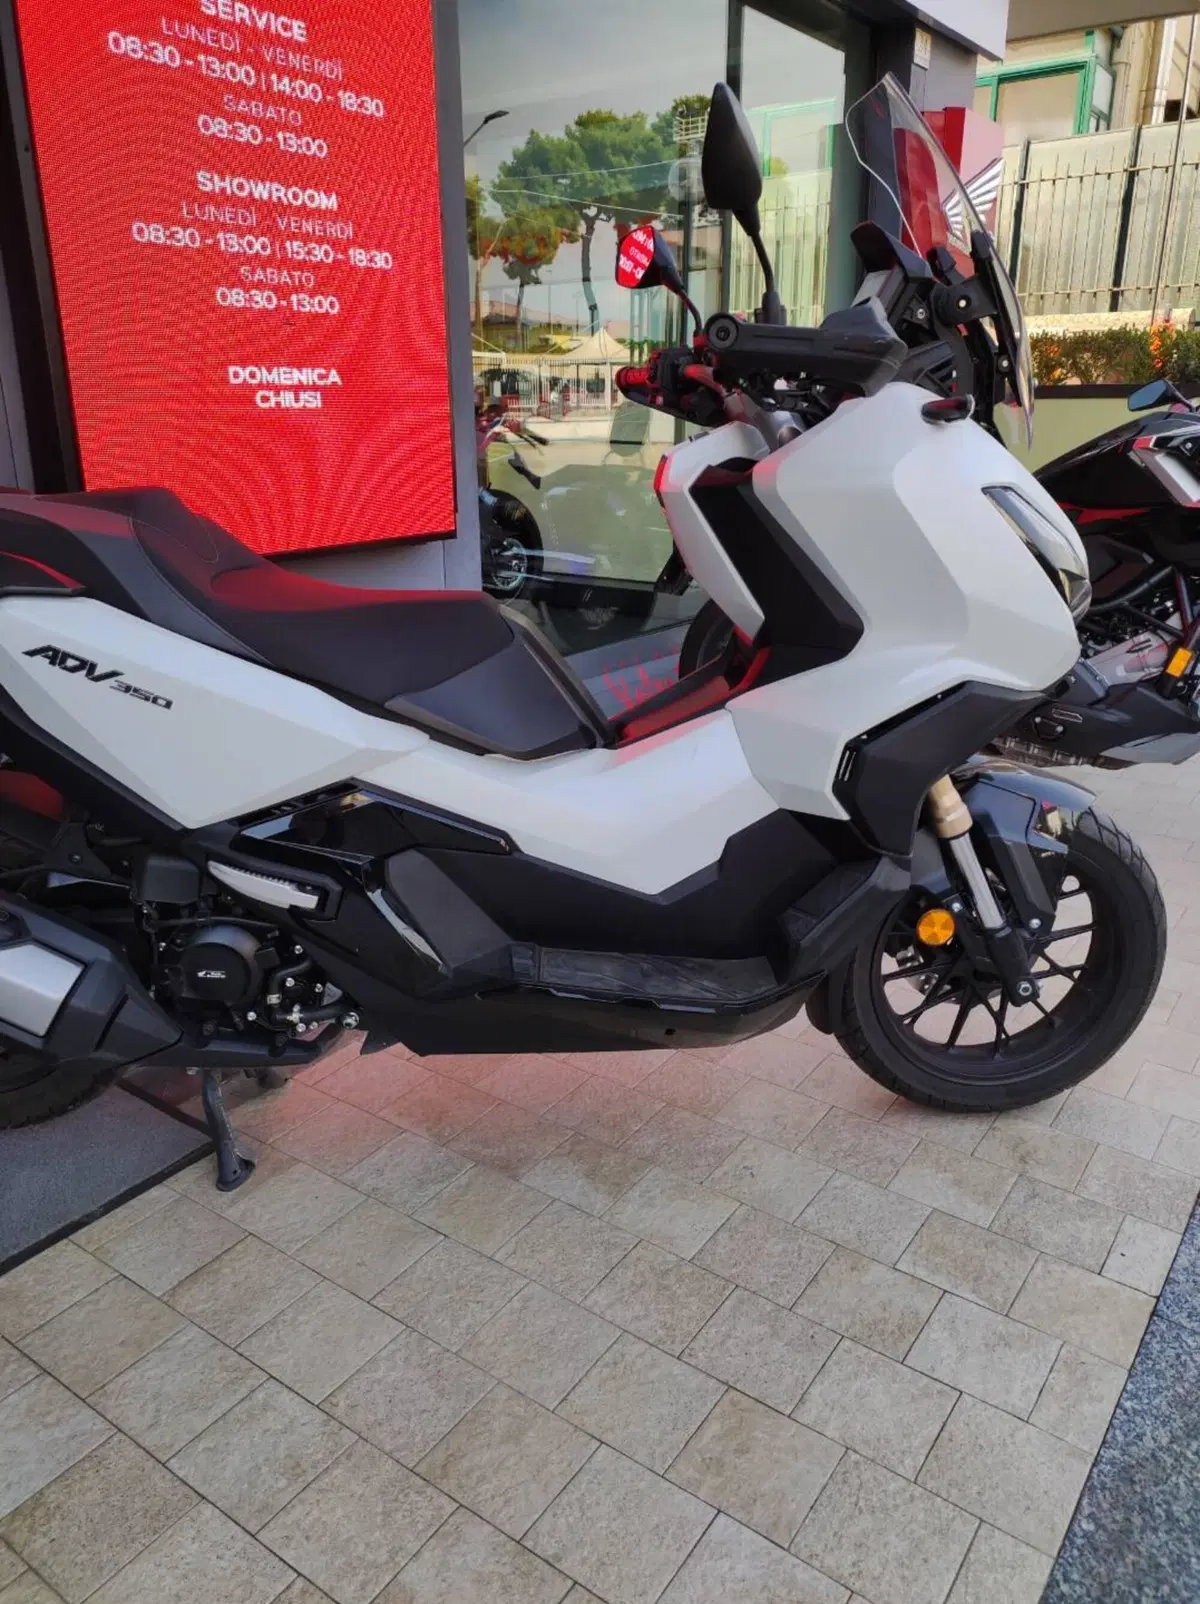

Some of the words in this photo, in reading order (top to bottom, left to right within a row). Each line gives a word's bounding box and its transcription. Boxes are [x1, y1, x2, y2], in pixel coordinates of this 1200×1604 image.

[200, 0, 307, 42] SERVICE
[107, 31, 180, 68] 08:30
[198, 53, 256, 87] 13:00
[270, 73, 322, 104] 14:00
[337, 88, 384, 118] 18:30
[223, 94, 301, 127] SABATO
[197, 114, 263, 146] 08:30
[276, 131, 328, 159] 13:00
[196, 170, 338, 211] SHOWROOM
[132, 222, 201, 248] 08:30
[216, 232, 271, 256] 13:00
[285, 239, 334, 264] 15:30
[349, 247, 392, 270] 18:30
[240, 266, 315, 288] SABATO
[216, 287, 277, 309] 08:30
[290, 293, 339, 314] 13:00
[228, 365, 343, 387] DOMENICA
[255, 389, 322, 409] CHIUSI
[22, 644, 125, 682] ADV
[109, 679, 174, 710] 350
